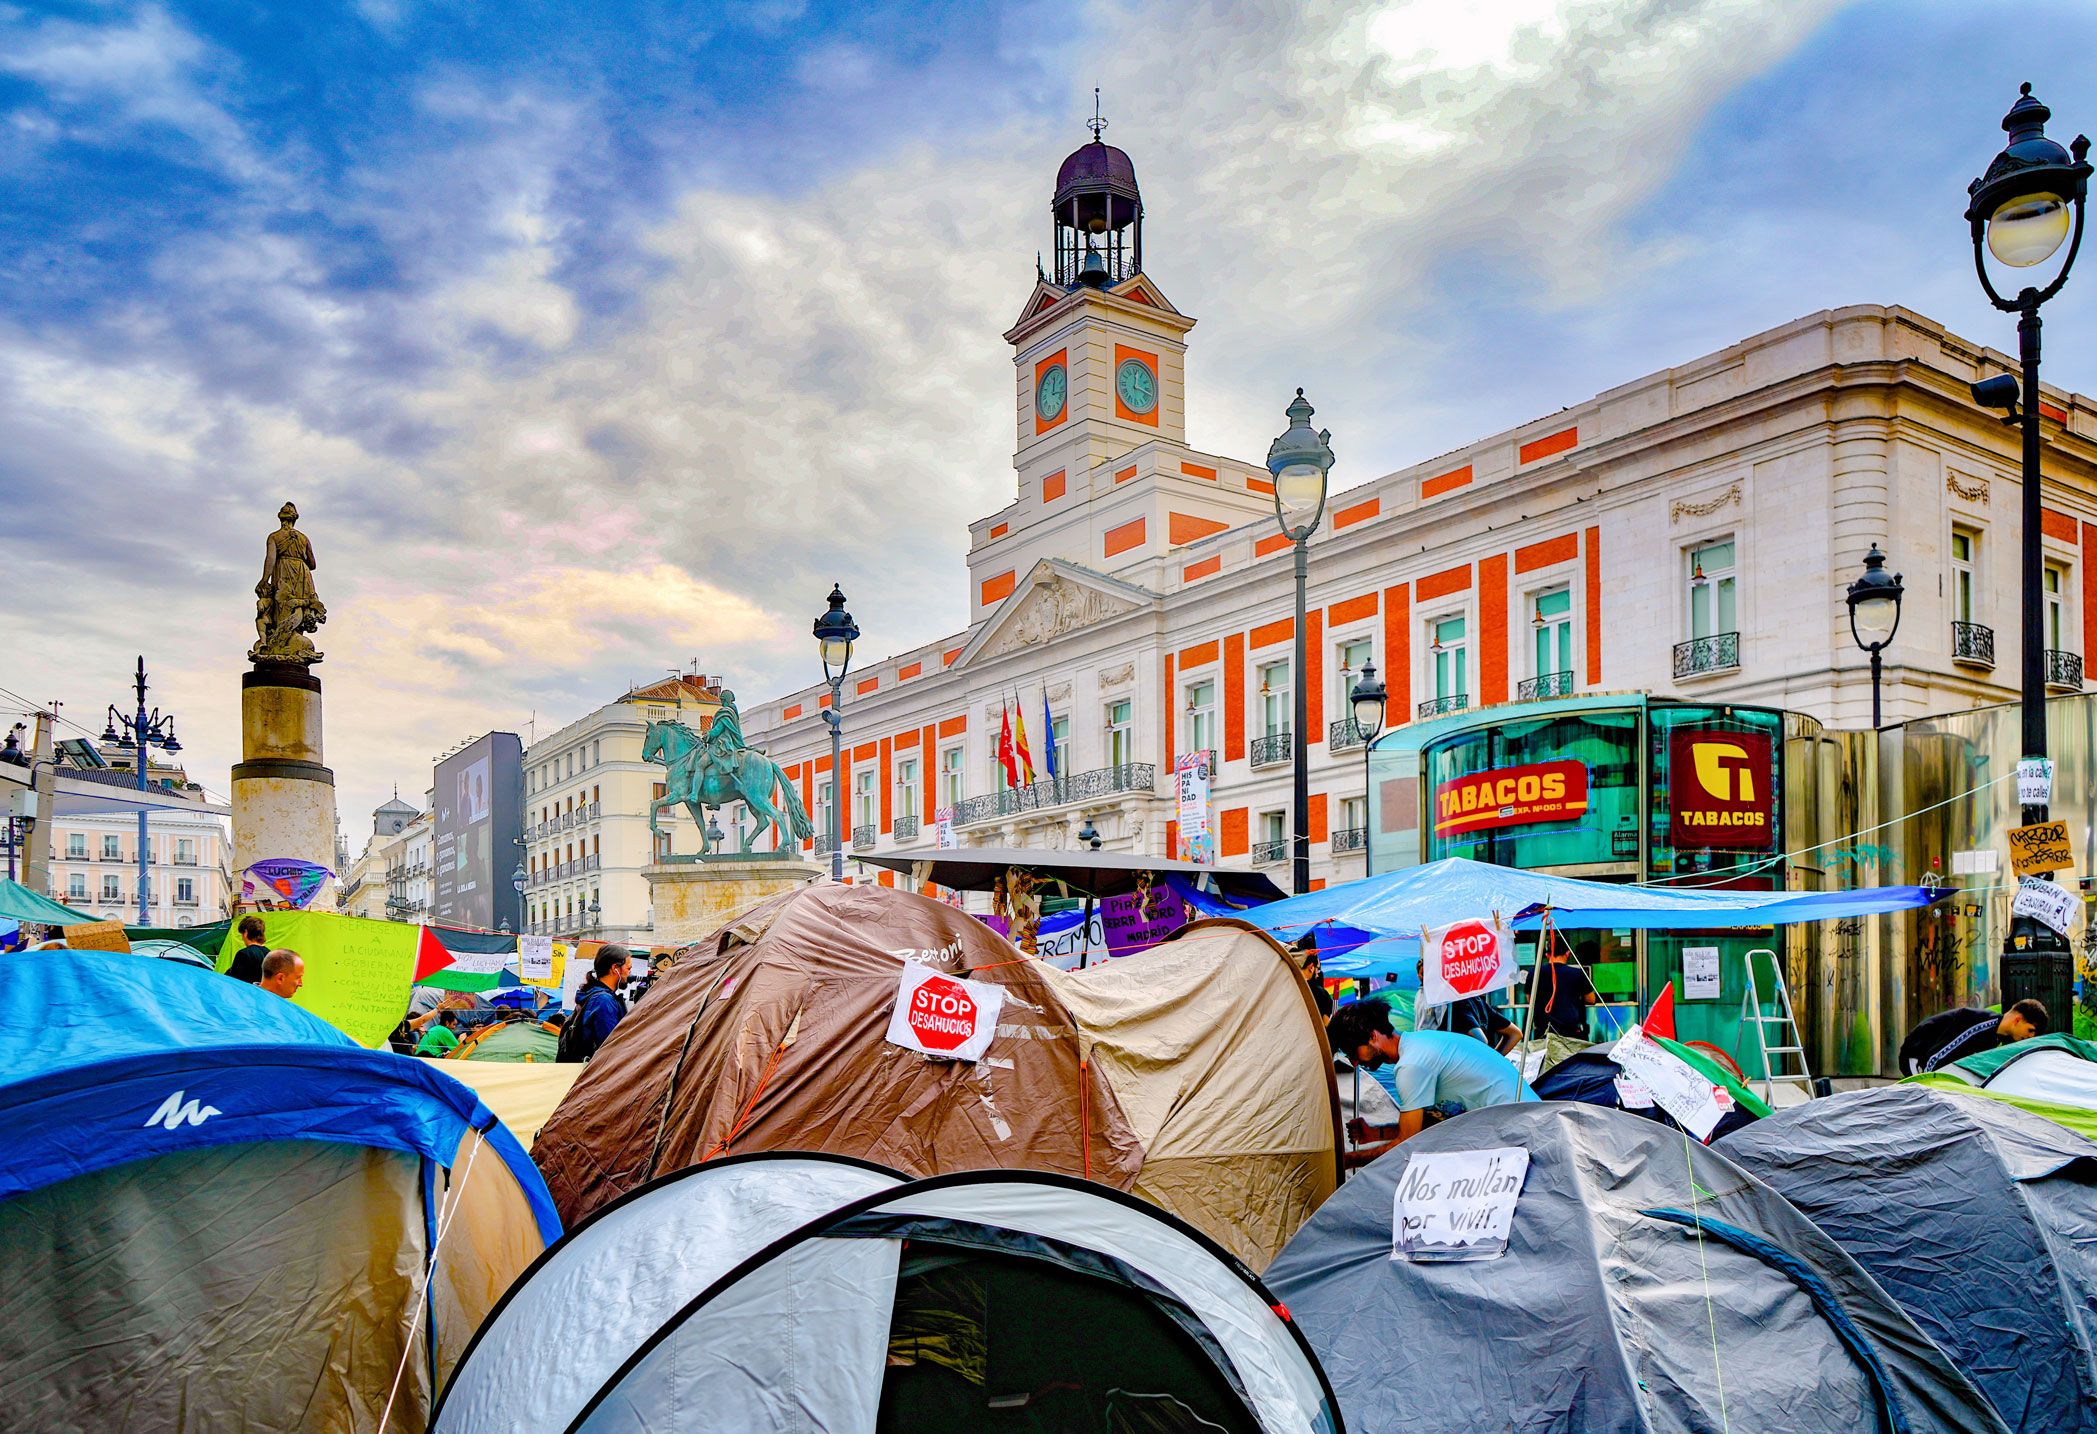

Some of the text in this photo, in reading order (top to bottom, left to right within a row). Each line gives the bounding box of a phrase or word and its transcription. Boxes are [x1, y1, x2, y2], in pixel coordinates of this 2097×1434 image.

[1440, 772, 1565, 818] TABACOS
[1680, 811, 1765, 826] TABACOS
[1444, 934, 1491, 959] STOP
[1444, 954, 1498, 979] DESAHUCIOS
[915, 989, 972, 1016] STOP
[911, 1010, 973, 1038] DESAHUCIOS
[1400, 1157, 1518, 1203] Nos multan
[1402, 1203, 1498, 1246] por vivir.
